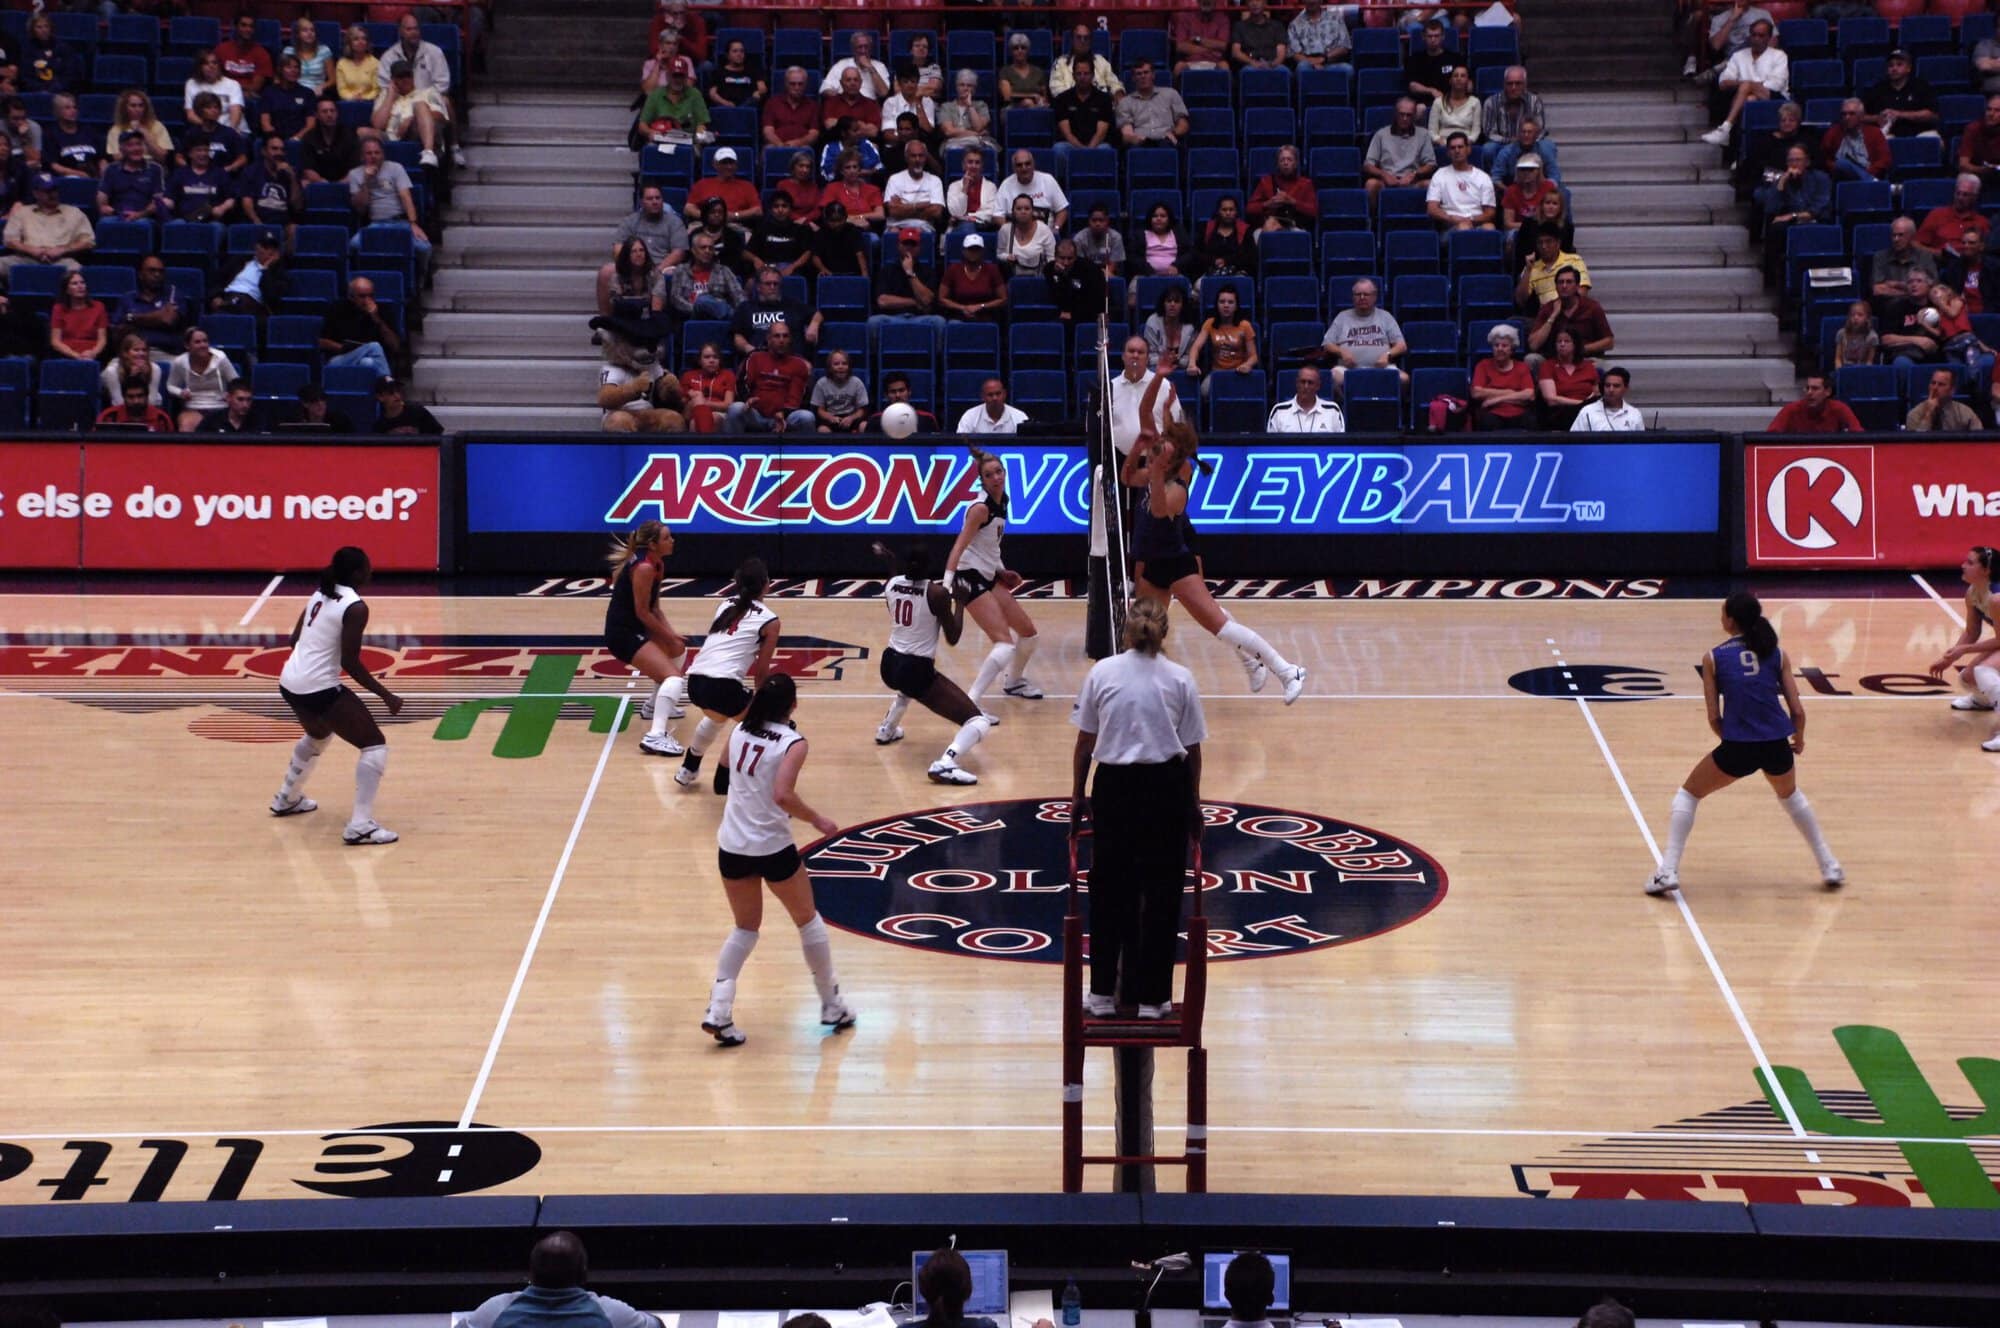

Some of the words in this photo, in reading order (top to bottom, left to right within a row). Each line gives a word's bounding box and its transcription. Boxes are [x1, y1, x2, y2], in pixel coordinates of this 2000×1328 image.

[752, 311, 785, 325] UMC
[17, 485, 113, 518] else
[125, 485, 182, 519] do
[194, 492, 272, 526] you
[284, 488, 418, 520] need?
[1911, 483, 2000, 517] Wha
[307, 600, 323, 627] 9
[895, 598, 913, 627] 10
[1739, 650, 1760, 676] 9
[736, 741, 765, 777] 17
[808, 810, 1007, 881] LUTE
[875, 913, 1343, 957] CORT
